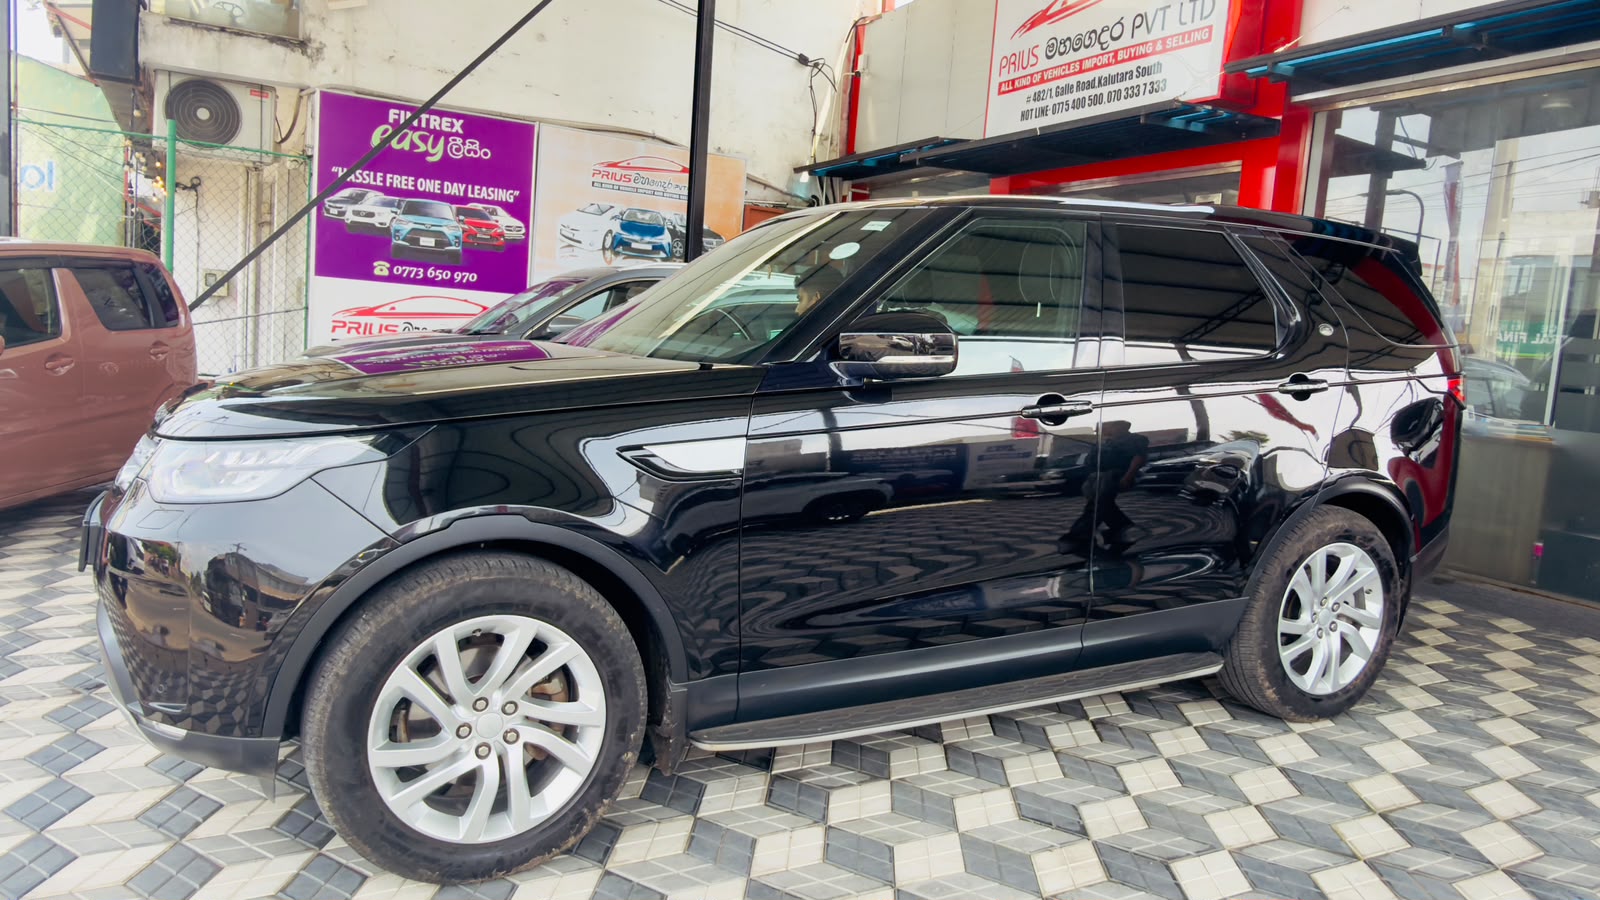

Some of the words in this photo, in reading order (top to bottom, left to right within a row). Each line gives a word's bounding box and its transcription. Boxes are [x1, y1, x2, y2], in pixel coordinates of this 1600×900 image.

[998, 44, 1040, 77] PRIUS
[1130, 4, 1171, 39] PVT
[1179, 0, 1216, 25] LTD
[1001, 80, 1013, 93] ALL
[1014, 75, 1031, 88] KIND
[1032, 71, 1043, 83] OF
[1043, 61, 1080, 80] VEHICLES
[1082, 52, 1116, 71] IMPORT,
[1117, 42, 1154, 62] BUYING
[1156, 39, 1163, 51] &
[1166, 28, 1209, 49] SELLING
[1055, 82, 1075, 98] Galle
[1135, 60, 1163, 79] South
[1051, 100, 1070, 116] 0775
[1071, 96, 1086, 110] 400
[1107, 88, 1122, 103] 070
[1123, 83, 1141, 100] 333
[370, 124, 445, 162] easy
[386, 173, 415, 191] FREE
[417, 177, 441, 194] ONE
[443, 181, 467, 197] DAY
[468, 184, 520, 204] LEASING”
[592, 169, 632, 183] PRIUS
[393, 264, 424, 279] 0773
[427, 267, 451, 281] 650
[453, 272, 478, 283] 970
[331, 320, 399, 335] PRIUS
